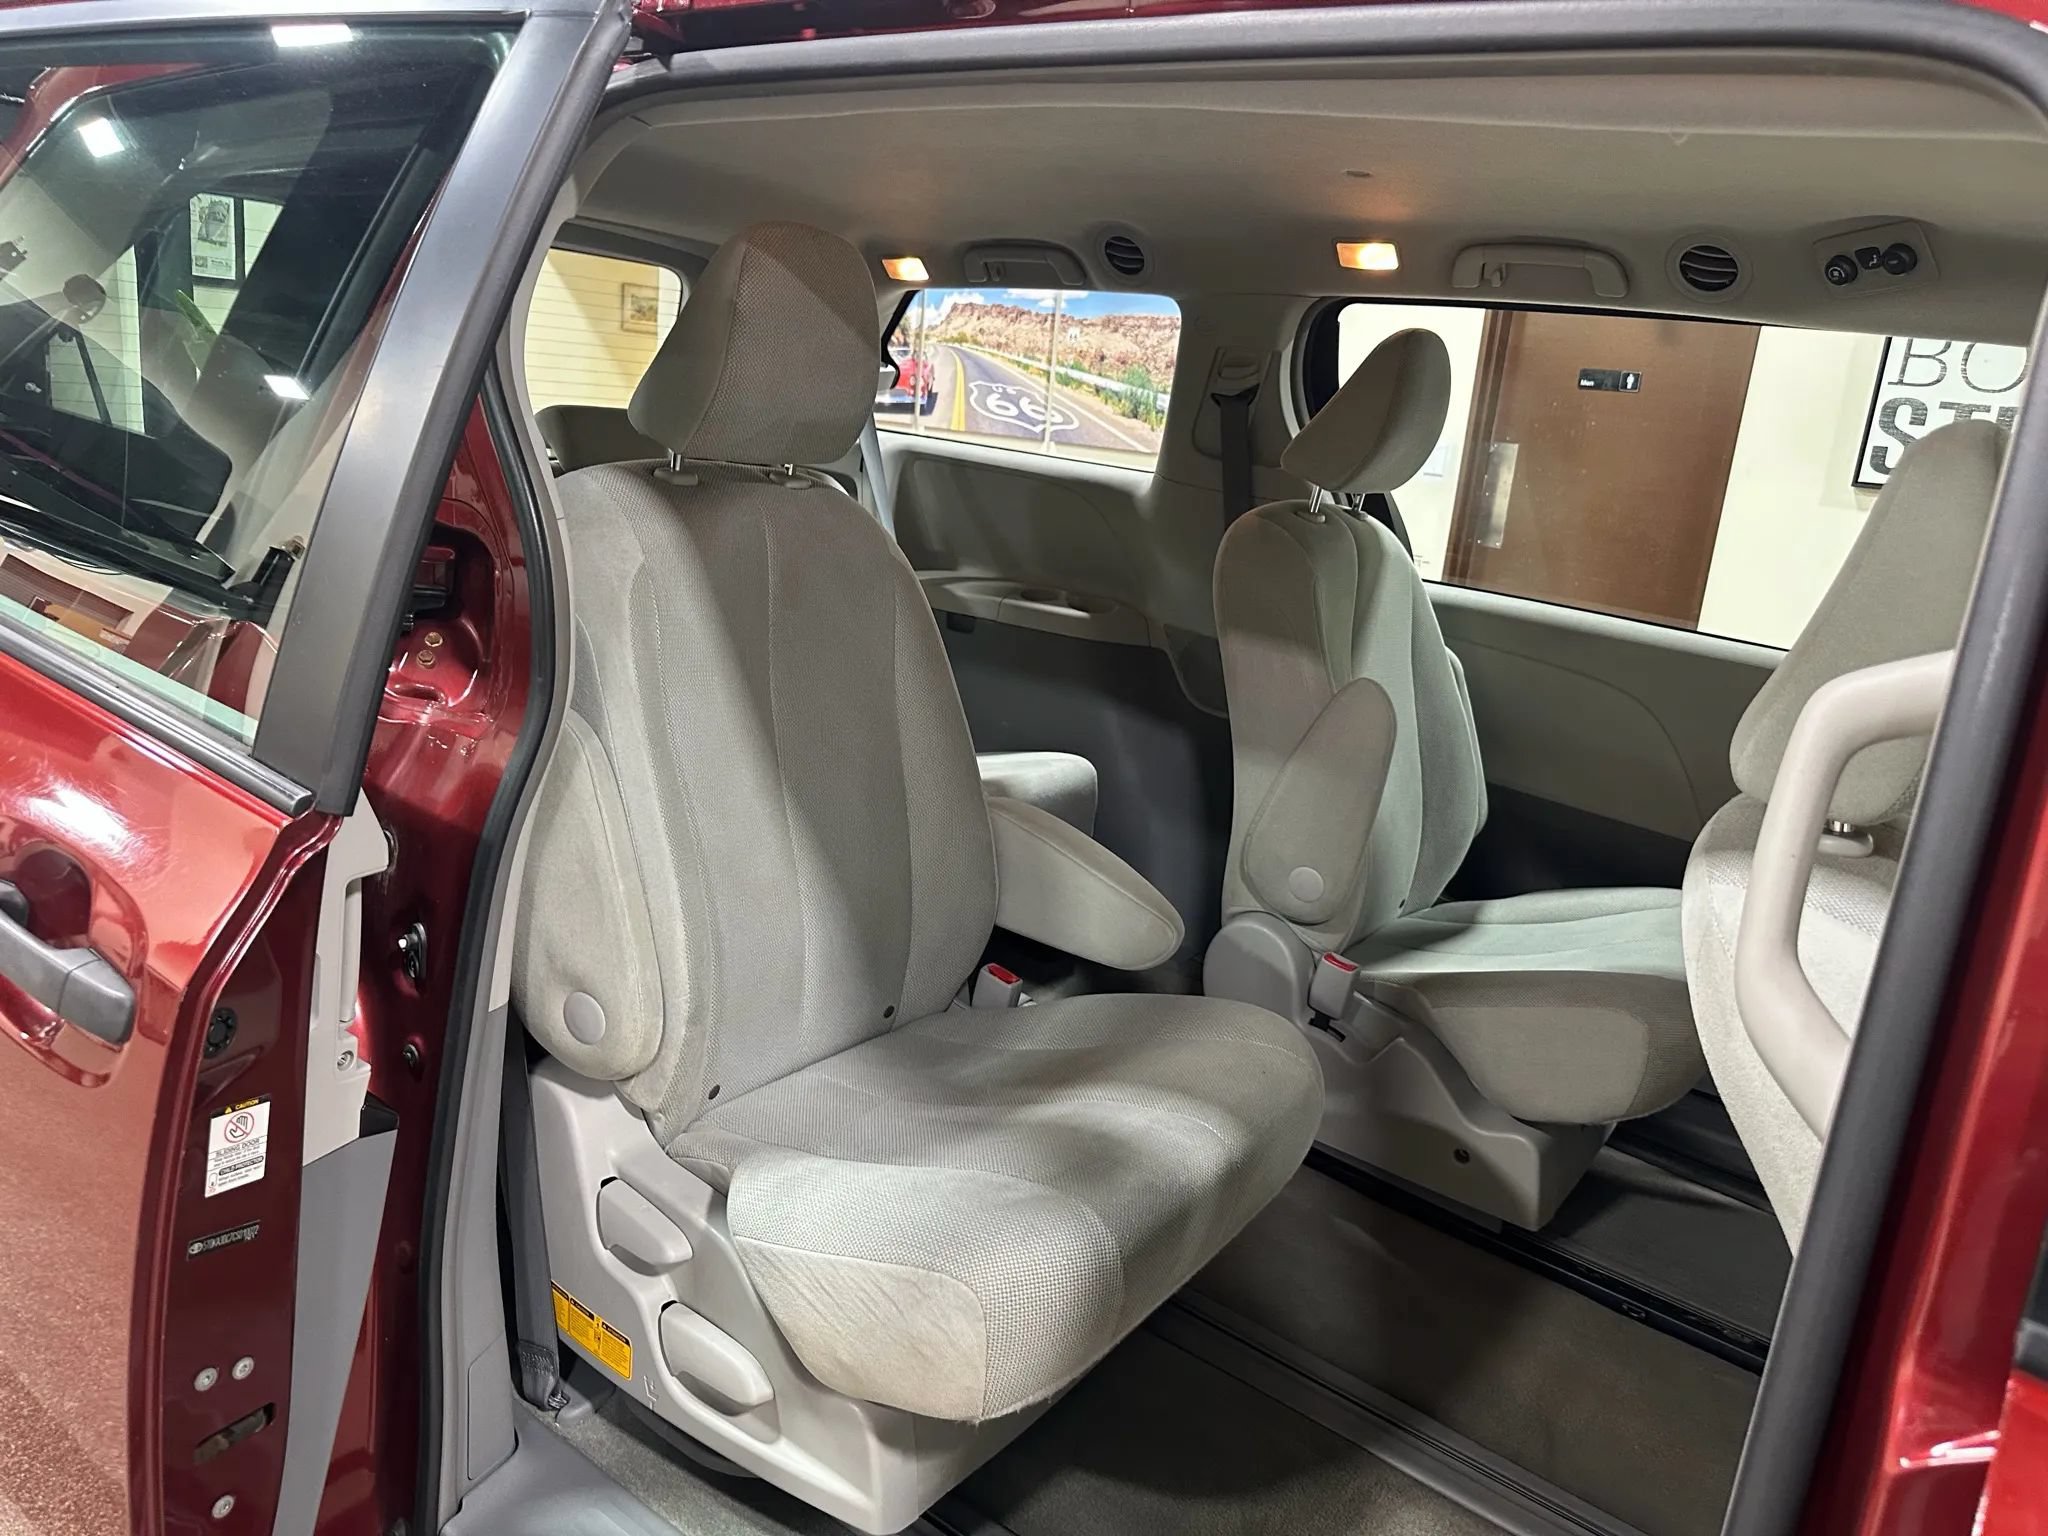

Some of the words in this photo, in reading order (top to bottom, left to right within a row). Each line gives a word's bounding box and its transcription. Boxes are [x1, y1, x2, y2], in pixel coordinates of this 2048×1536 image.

[1579, 378, 1595, 387] Men
[985, 392, 1064, 423] 66
[235, 1098, 260, 1110] CAUTION
[241, 1137, 260, 1149] DOOR
